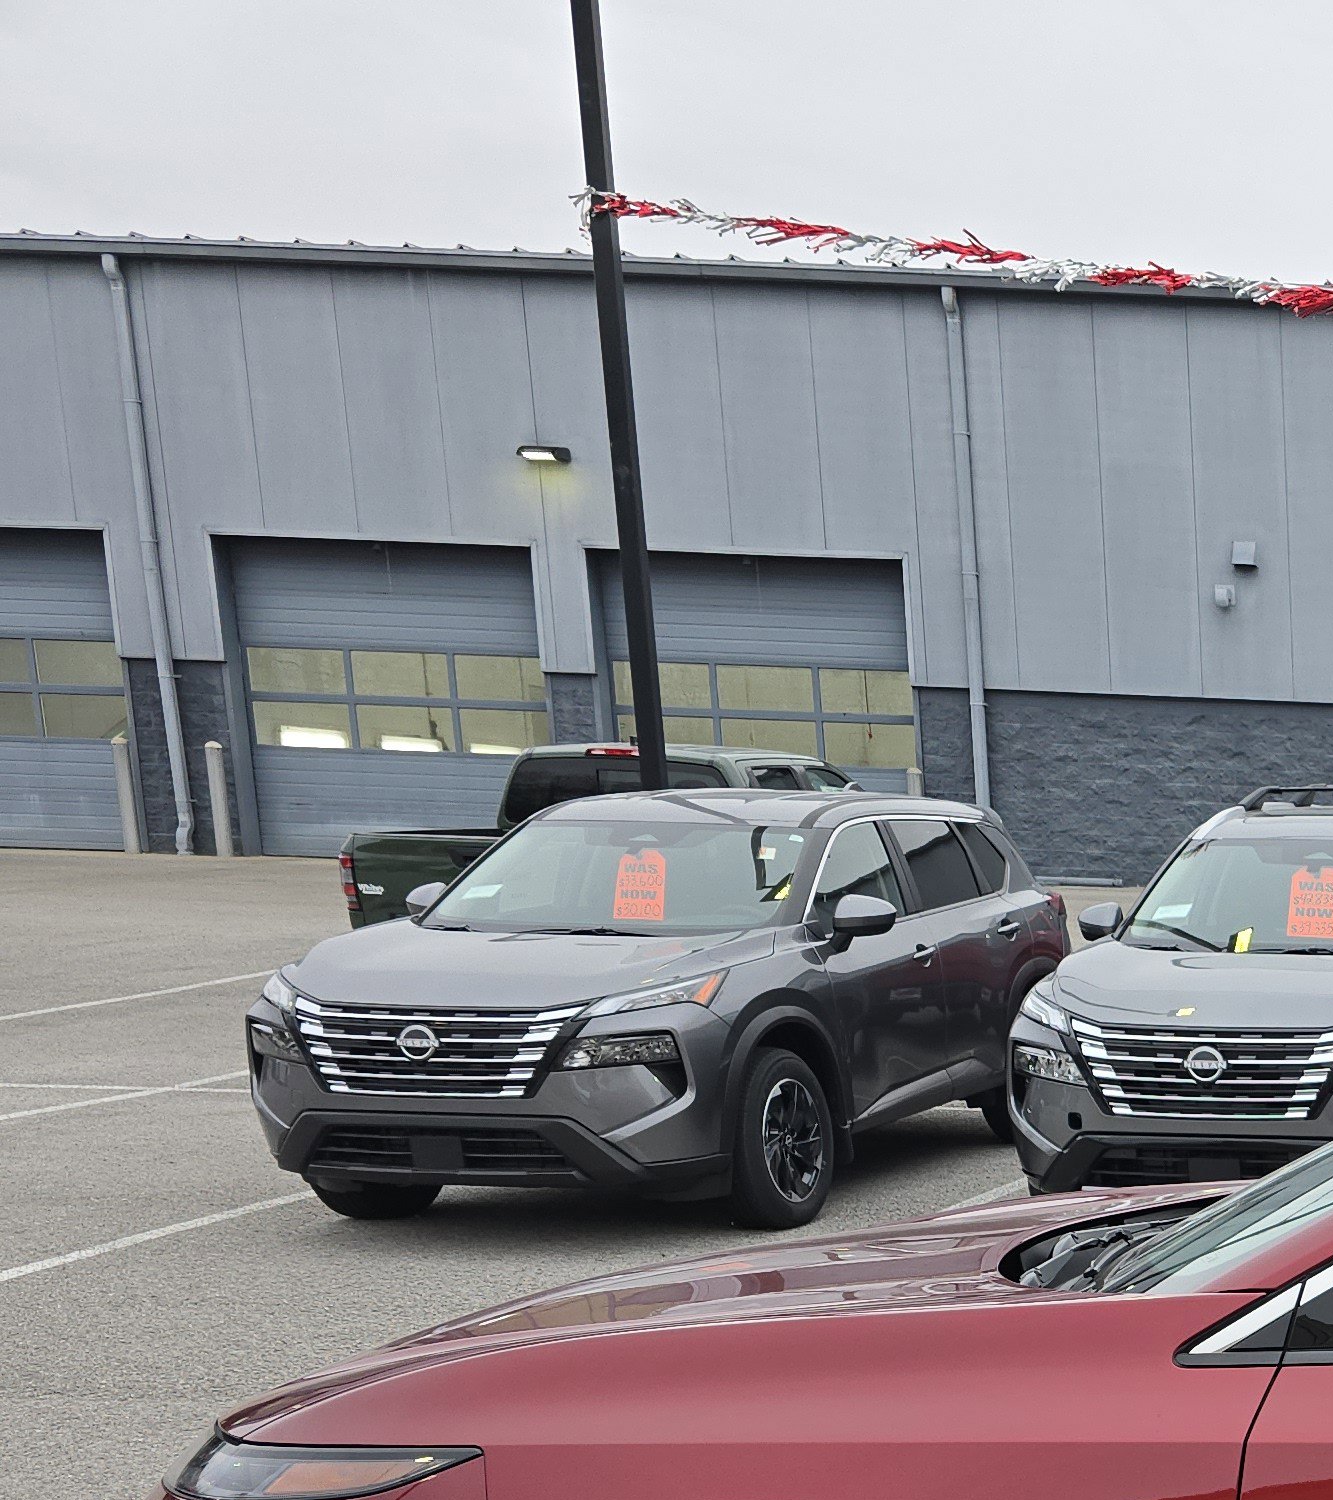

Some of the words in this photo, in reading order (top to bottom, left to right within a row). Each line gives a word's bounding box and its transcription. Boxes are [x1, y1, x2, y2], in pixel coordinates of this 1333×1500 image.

[624, 863, 659, 874] WAS
[620, 889, 658, 900] NOW
[1295, 907, 1333, 918] NOW
[1183, 1059, 1227, 1070] NISSAN
